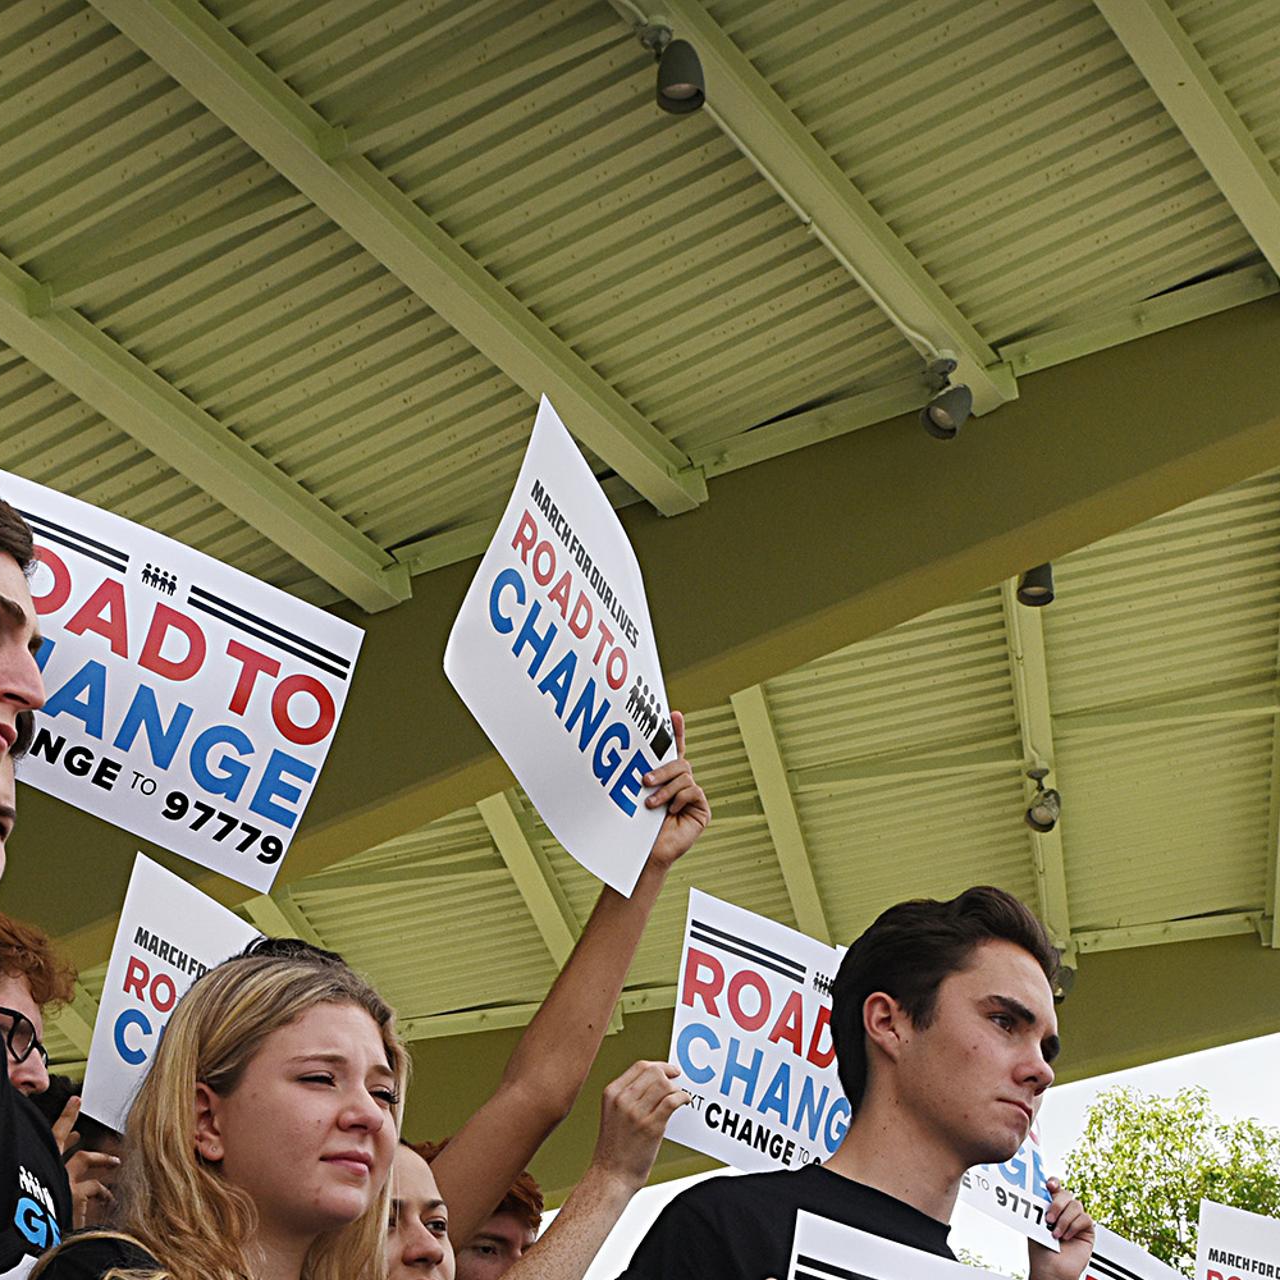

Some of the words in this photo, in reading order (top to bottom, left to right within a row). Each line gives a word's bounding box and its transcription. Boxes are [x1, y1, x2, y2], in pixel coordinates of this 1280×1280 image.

[511, 510, 593, 640] ROAD
[593, 619, 629, 691] TO
[531, 479, 571, 547] MARCH
[570, 535, 592, 578] FOR
[590, 566, 617, 609] OUR
[611, 598, 639, 649] LIVES
[31, 544, 207, 682] OAD
[226, 638, 336, 746] TO
[489, 568, 654, 819] CHANGE
[29, 727, 123, 792] NGE
[131, 771, 157, 796] TO
[161, 791, 284, 865] 97779
[34, 636, 316, 830] ANGE
[123, 955, 177, 1013] RO
[134, 927, 187, 971] MARCH
[676, 1023, 852, 1153] CHANG
[705, 1102, 796, 1166] CHANGE
[799, 1146, 810, 1164] TO
[975, 1174, 990, 1191] TO
[1208, 1248, 1250, 1271] MARCH
[1251, 1260, 1275, 1279] FOR
